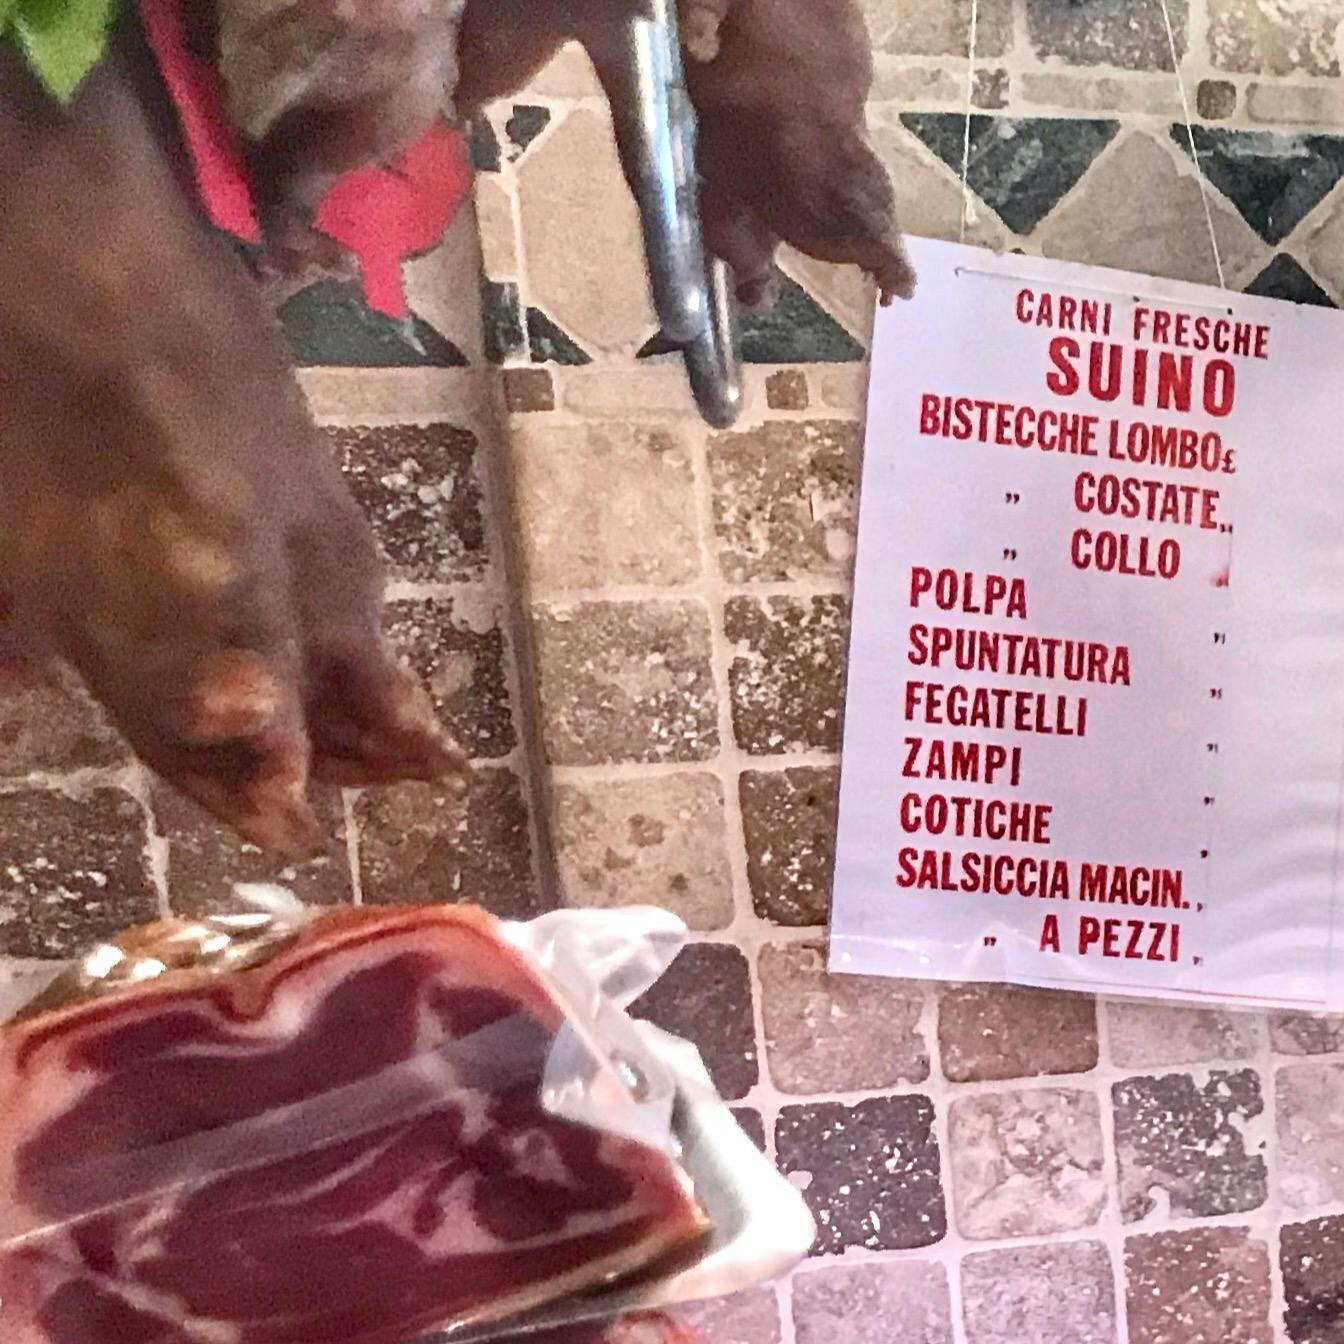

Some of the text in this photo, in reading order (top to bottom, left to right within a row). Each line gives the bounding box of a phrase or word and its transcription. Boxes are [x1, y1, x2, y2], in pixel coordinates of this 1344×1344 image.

[1015, 288, 1271, 360] CARNI FRESCHE
[1045, 336, 1236, 418] SUINO
[919, 393, 1098, 457] BISTECCHE
[1073, 471, 1220, 530] COSTATE
[1070, 528, 1182, 580] COLLO
[909, 566, 1028, 620] POLPA
[907, 623, 1132, 686] SPUNTATURA
[904, 680, 1088, 737] FEGATELLI
[901, 737, 1021, 786] ZAMPI
[900, 792, 1053, 845] COTICHE
[896, 847, 1190, 911] SALSICCIA MACIN.
[1039, 914, 1060, 954] A
[1078, 915, 1180, 963] PEZZI
